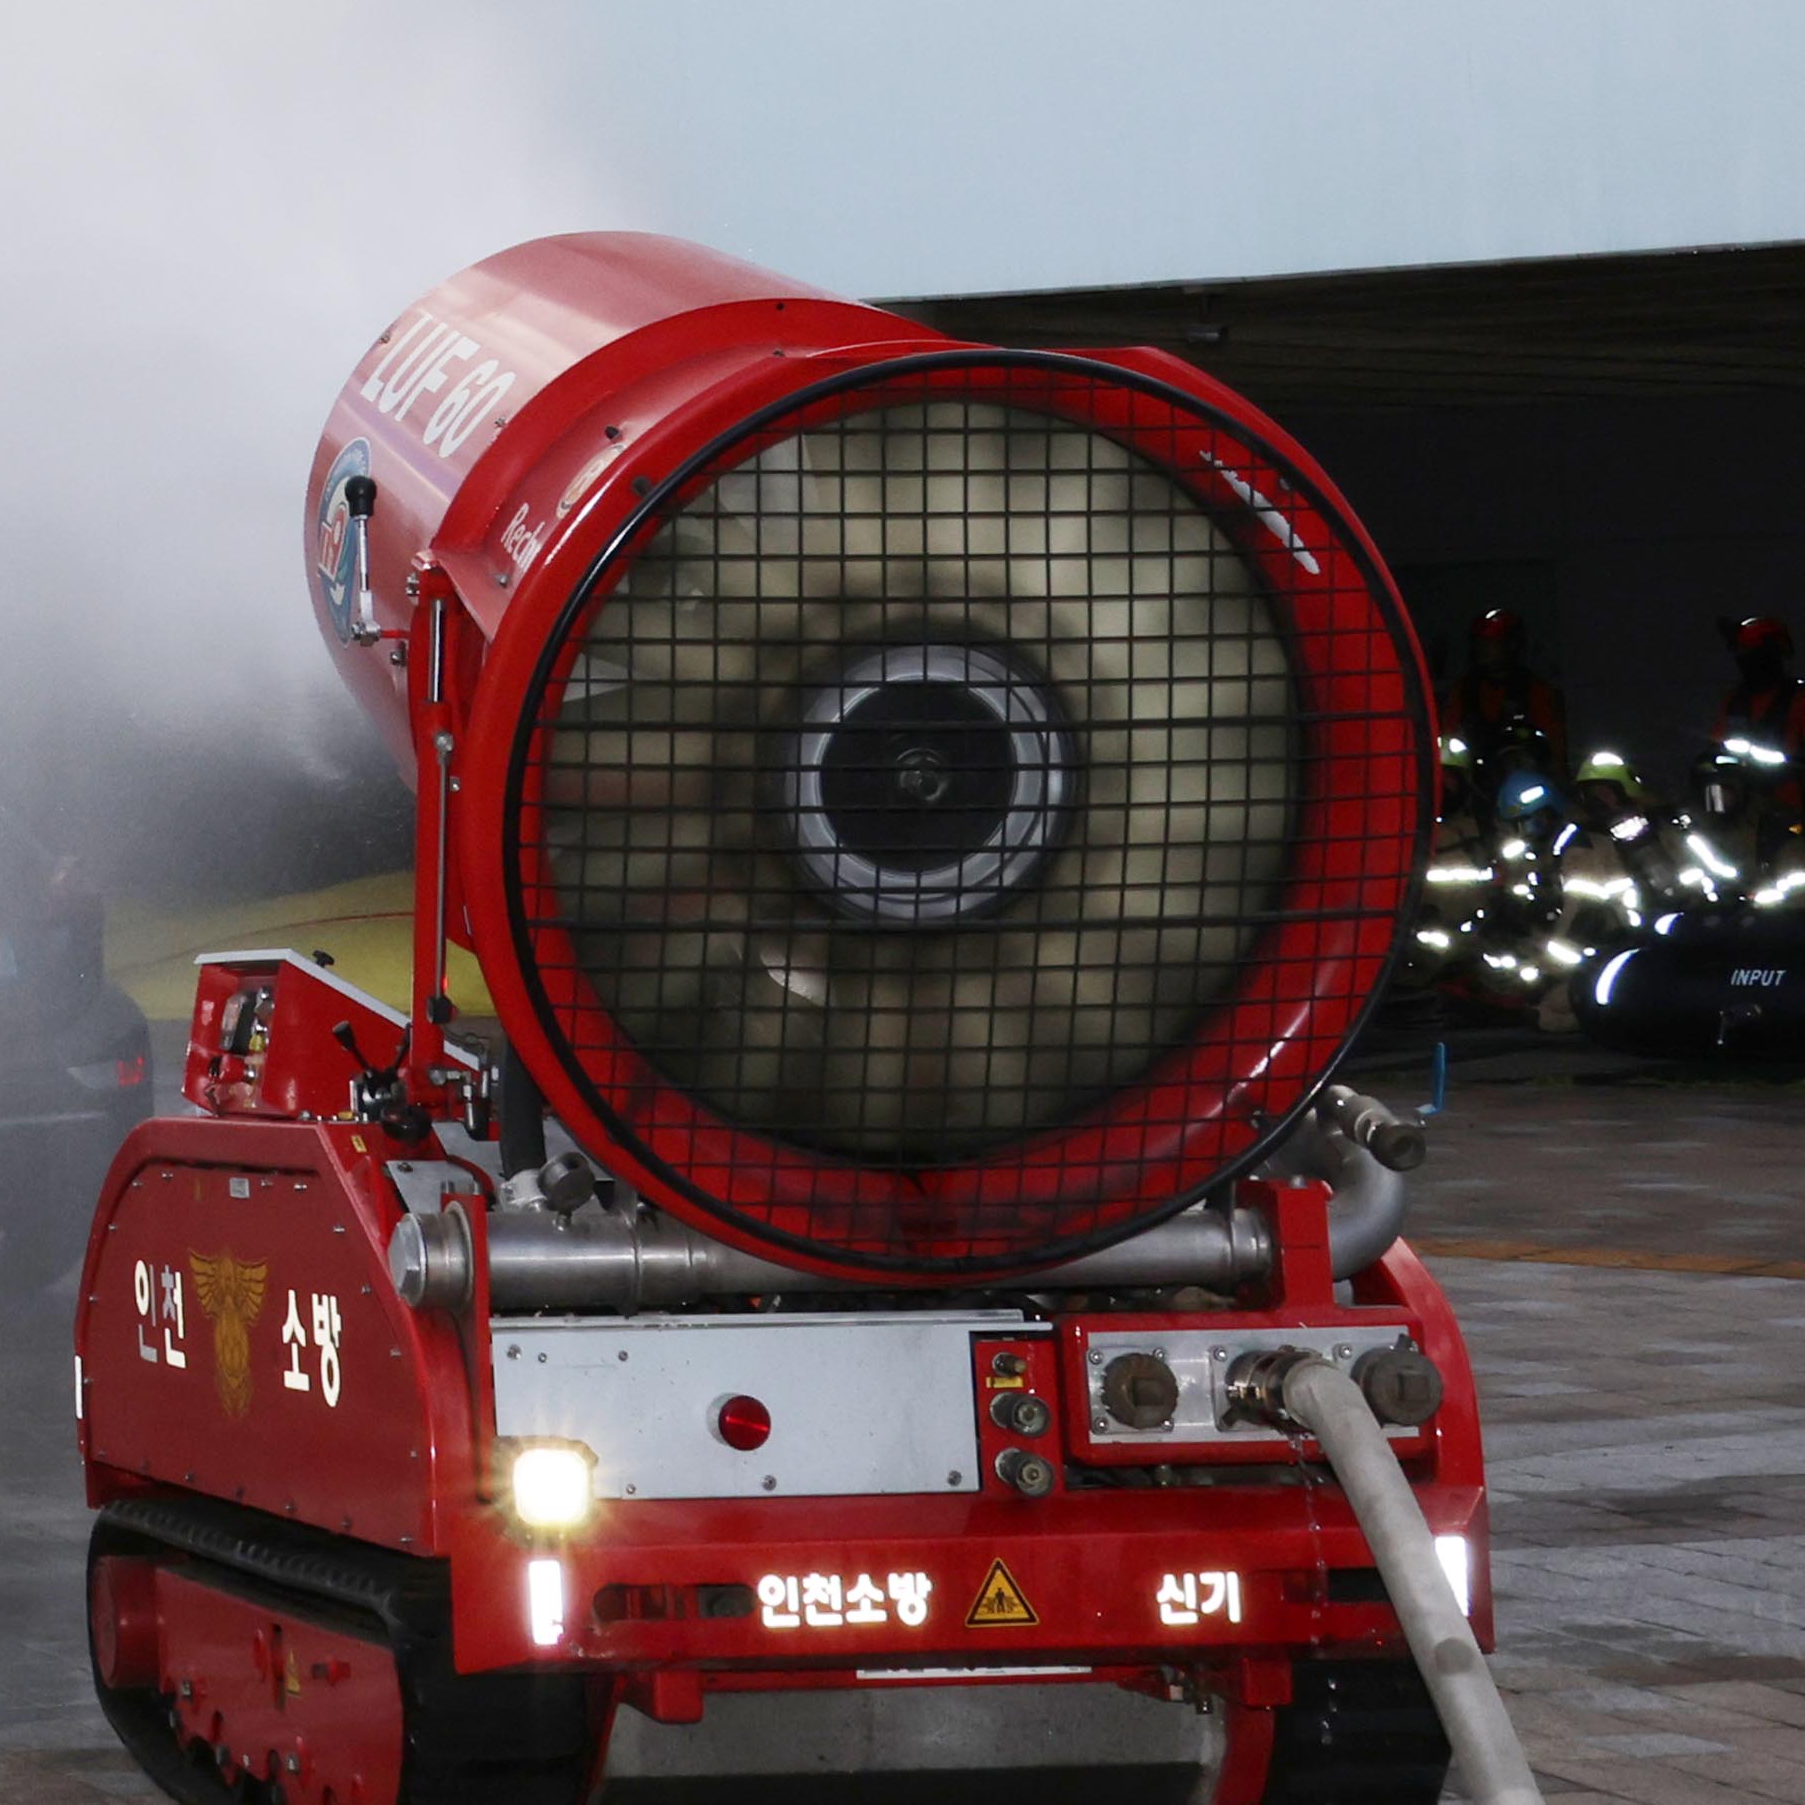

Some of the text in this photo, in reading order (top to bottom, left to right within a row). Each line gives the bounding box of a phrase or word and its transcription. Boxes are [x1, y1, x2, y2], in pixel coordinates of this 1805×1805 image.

[1730, 968, 1787, 988] INPUT
[134, 1259, 342, 1408] 인천 소방
[757, 1570, 1243, 1629] 인천소방 신기
